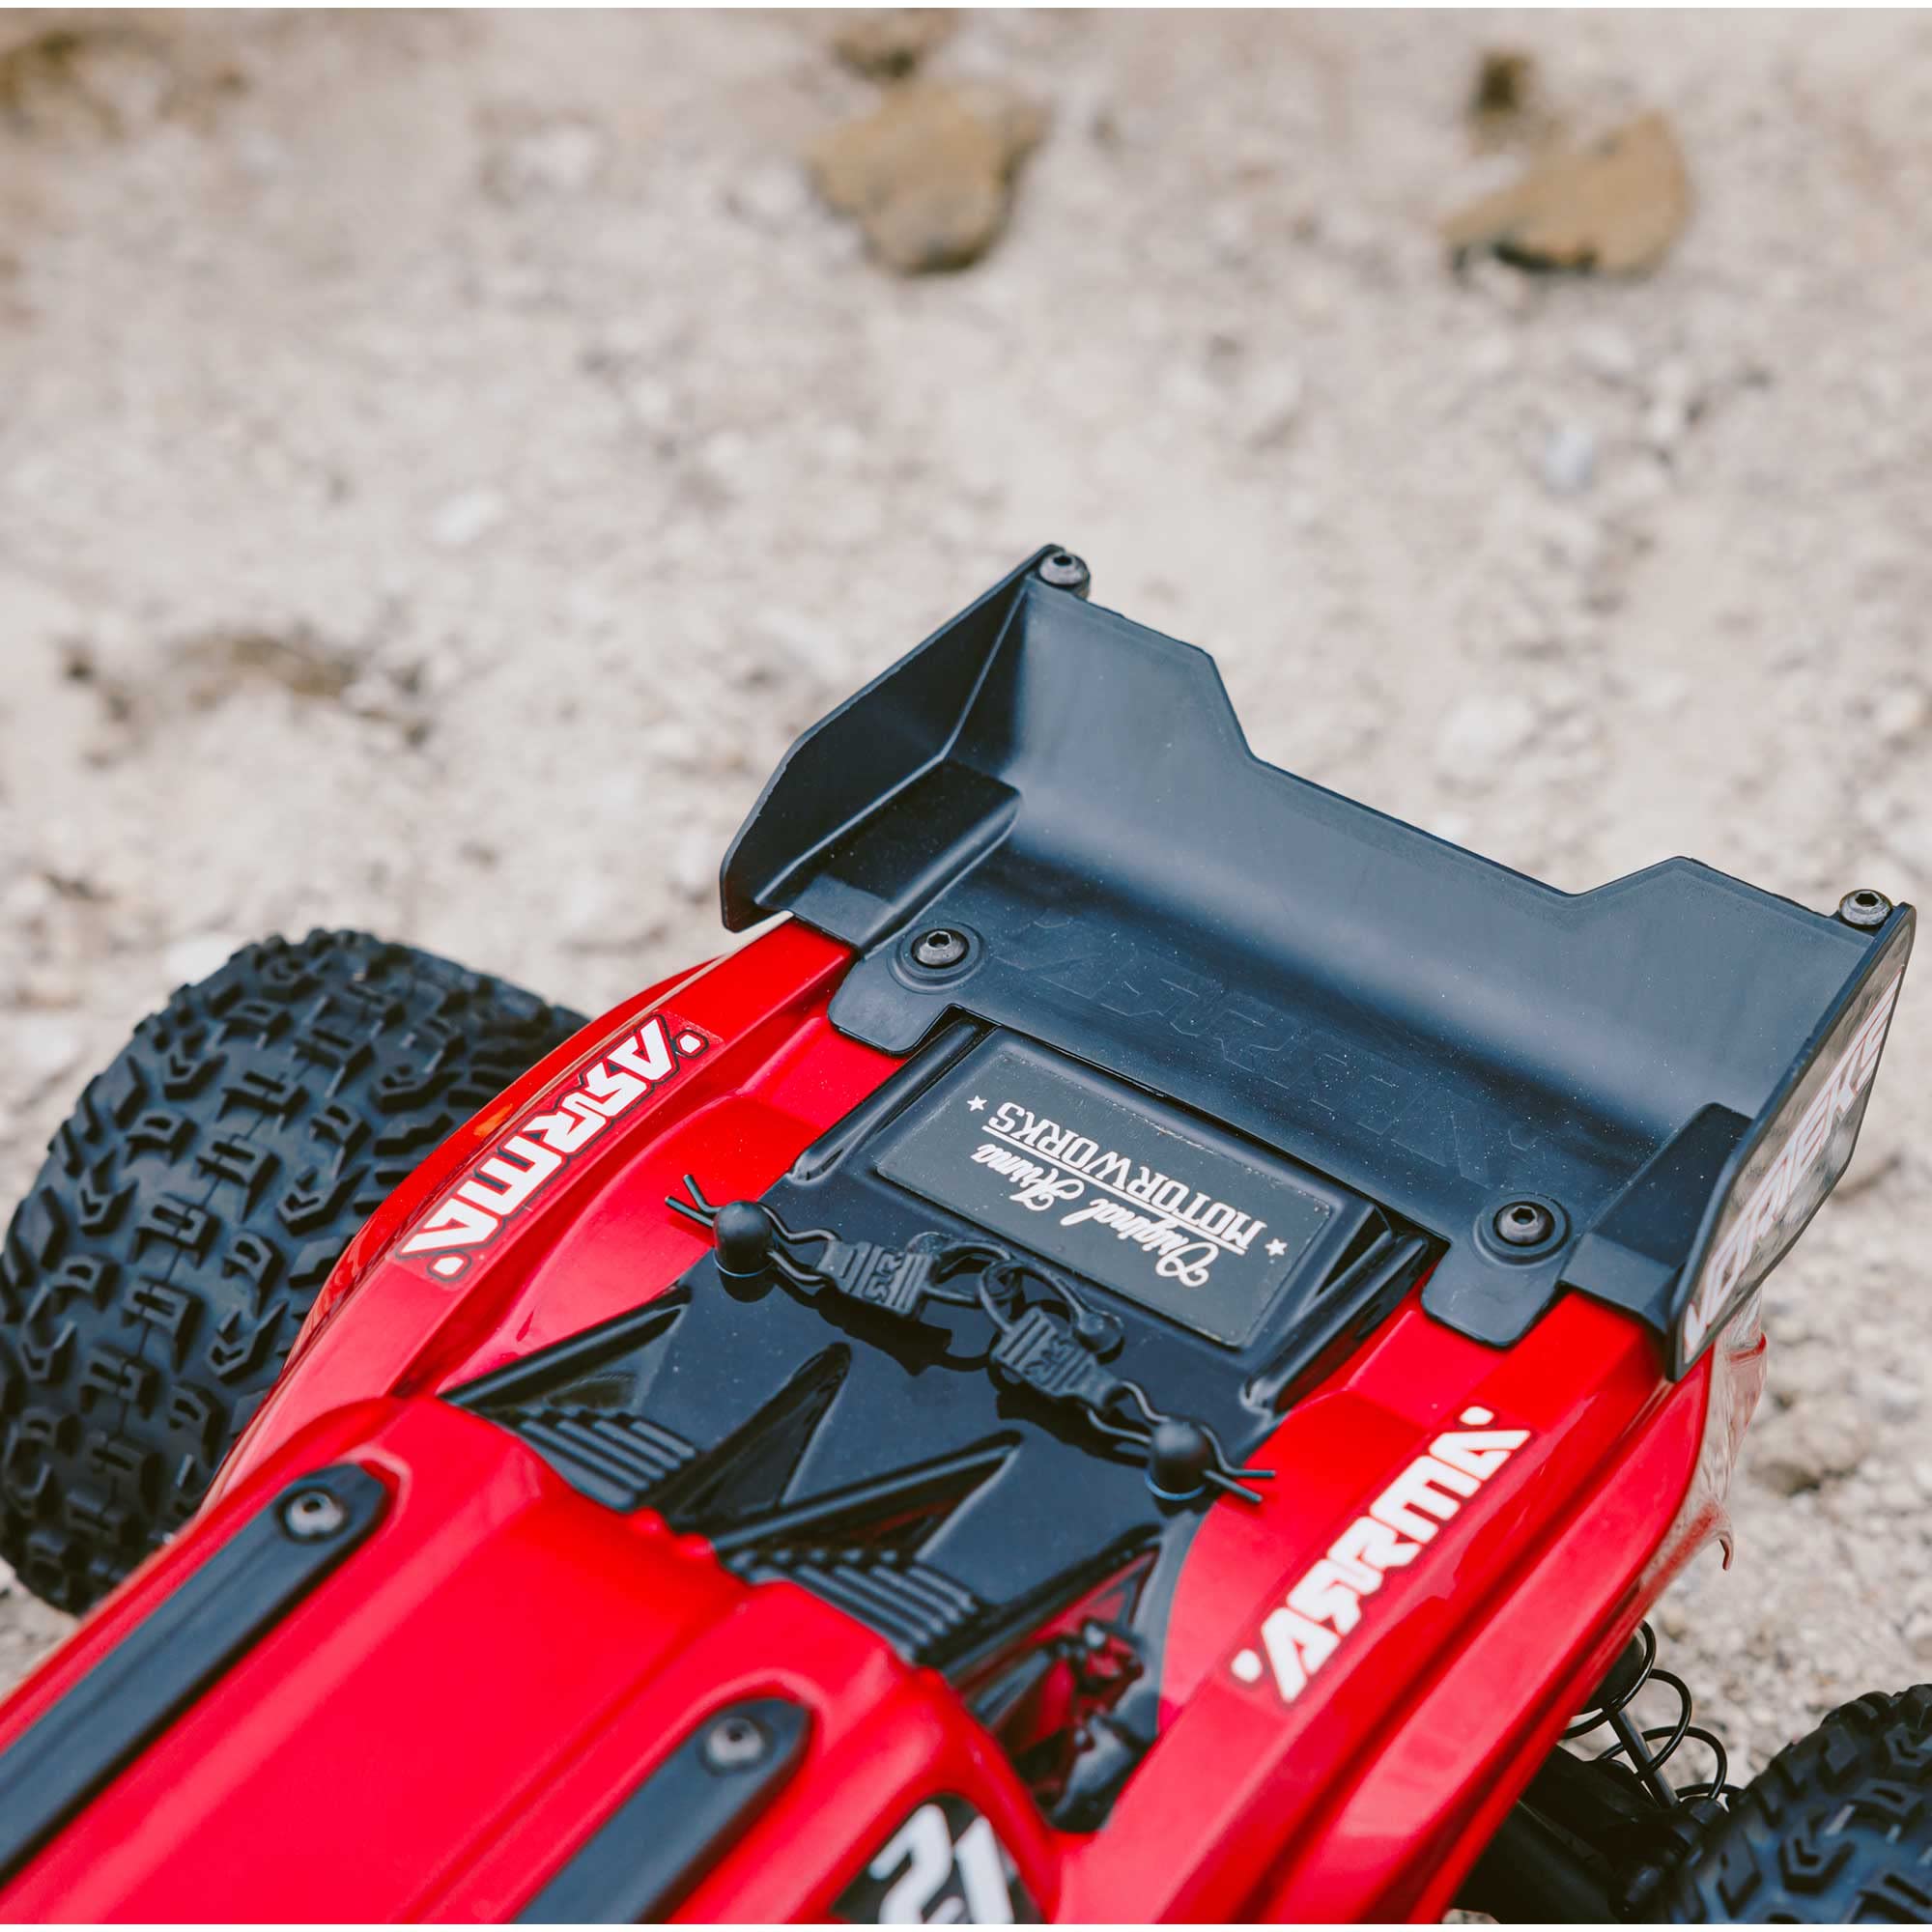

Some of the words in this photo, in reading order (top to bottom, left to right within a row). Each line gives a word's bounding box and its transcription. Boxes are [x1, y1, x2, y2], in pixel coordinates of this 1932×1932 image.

[970, 1143, 1085, 1211] Arrma
[987, 1101, 1267, 1249] MOTORWORKS
[1060, 1197, 1221, 1288] Original
[867, 1803, 1015, 1924] 21
